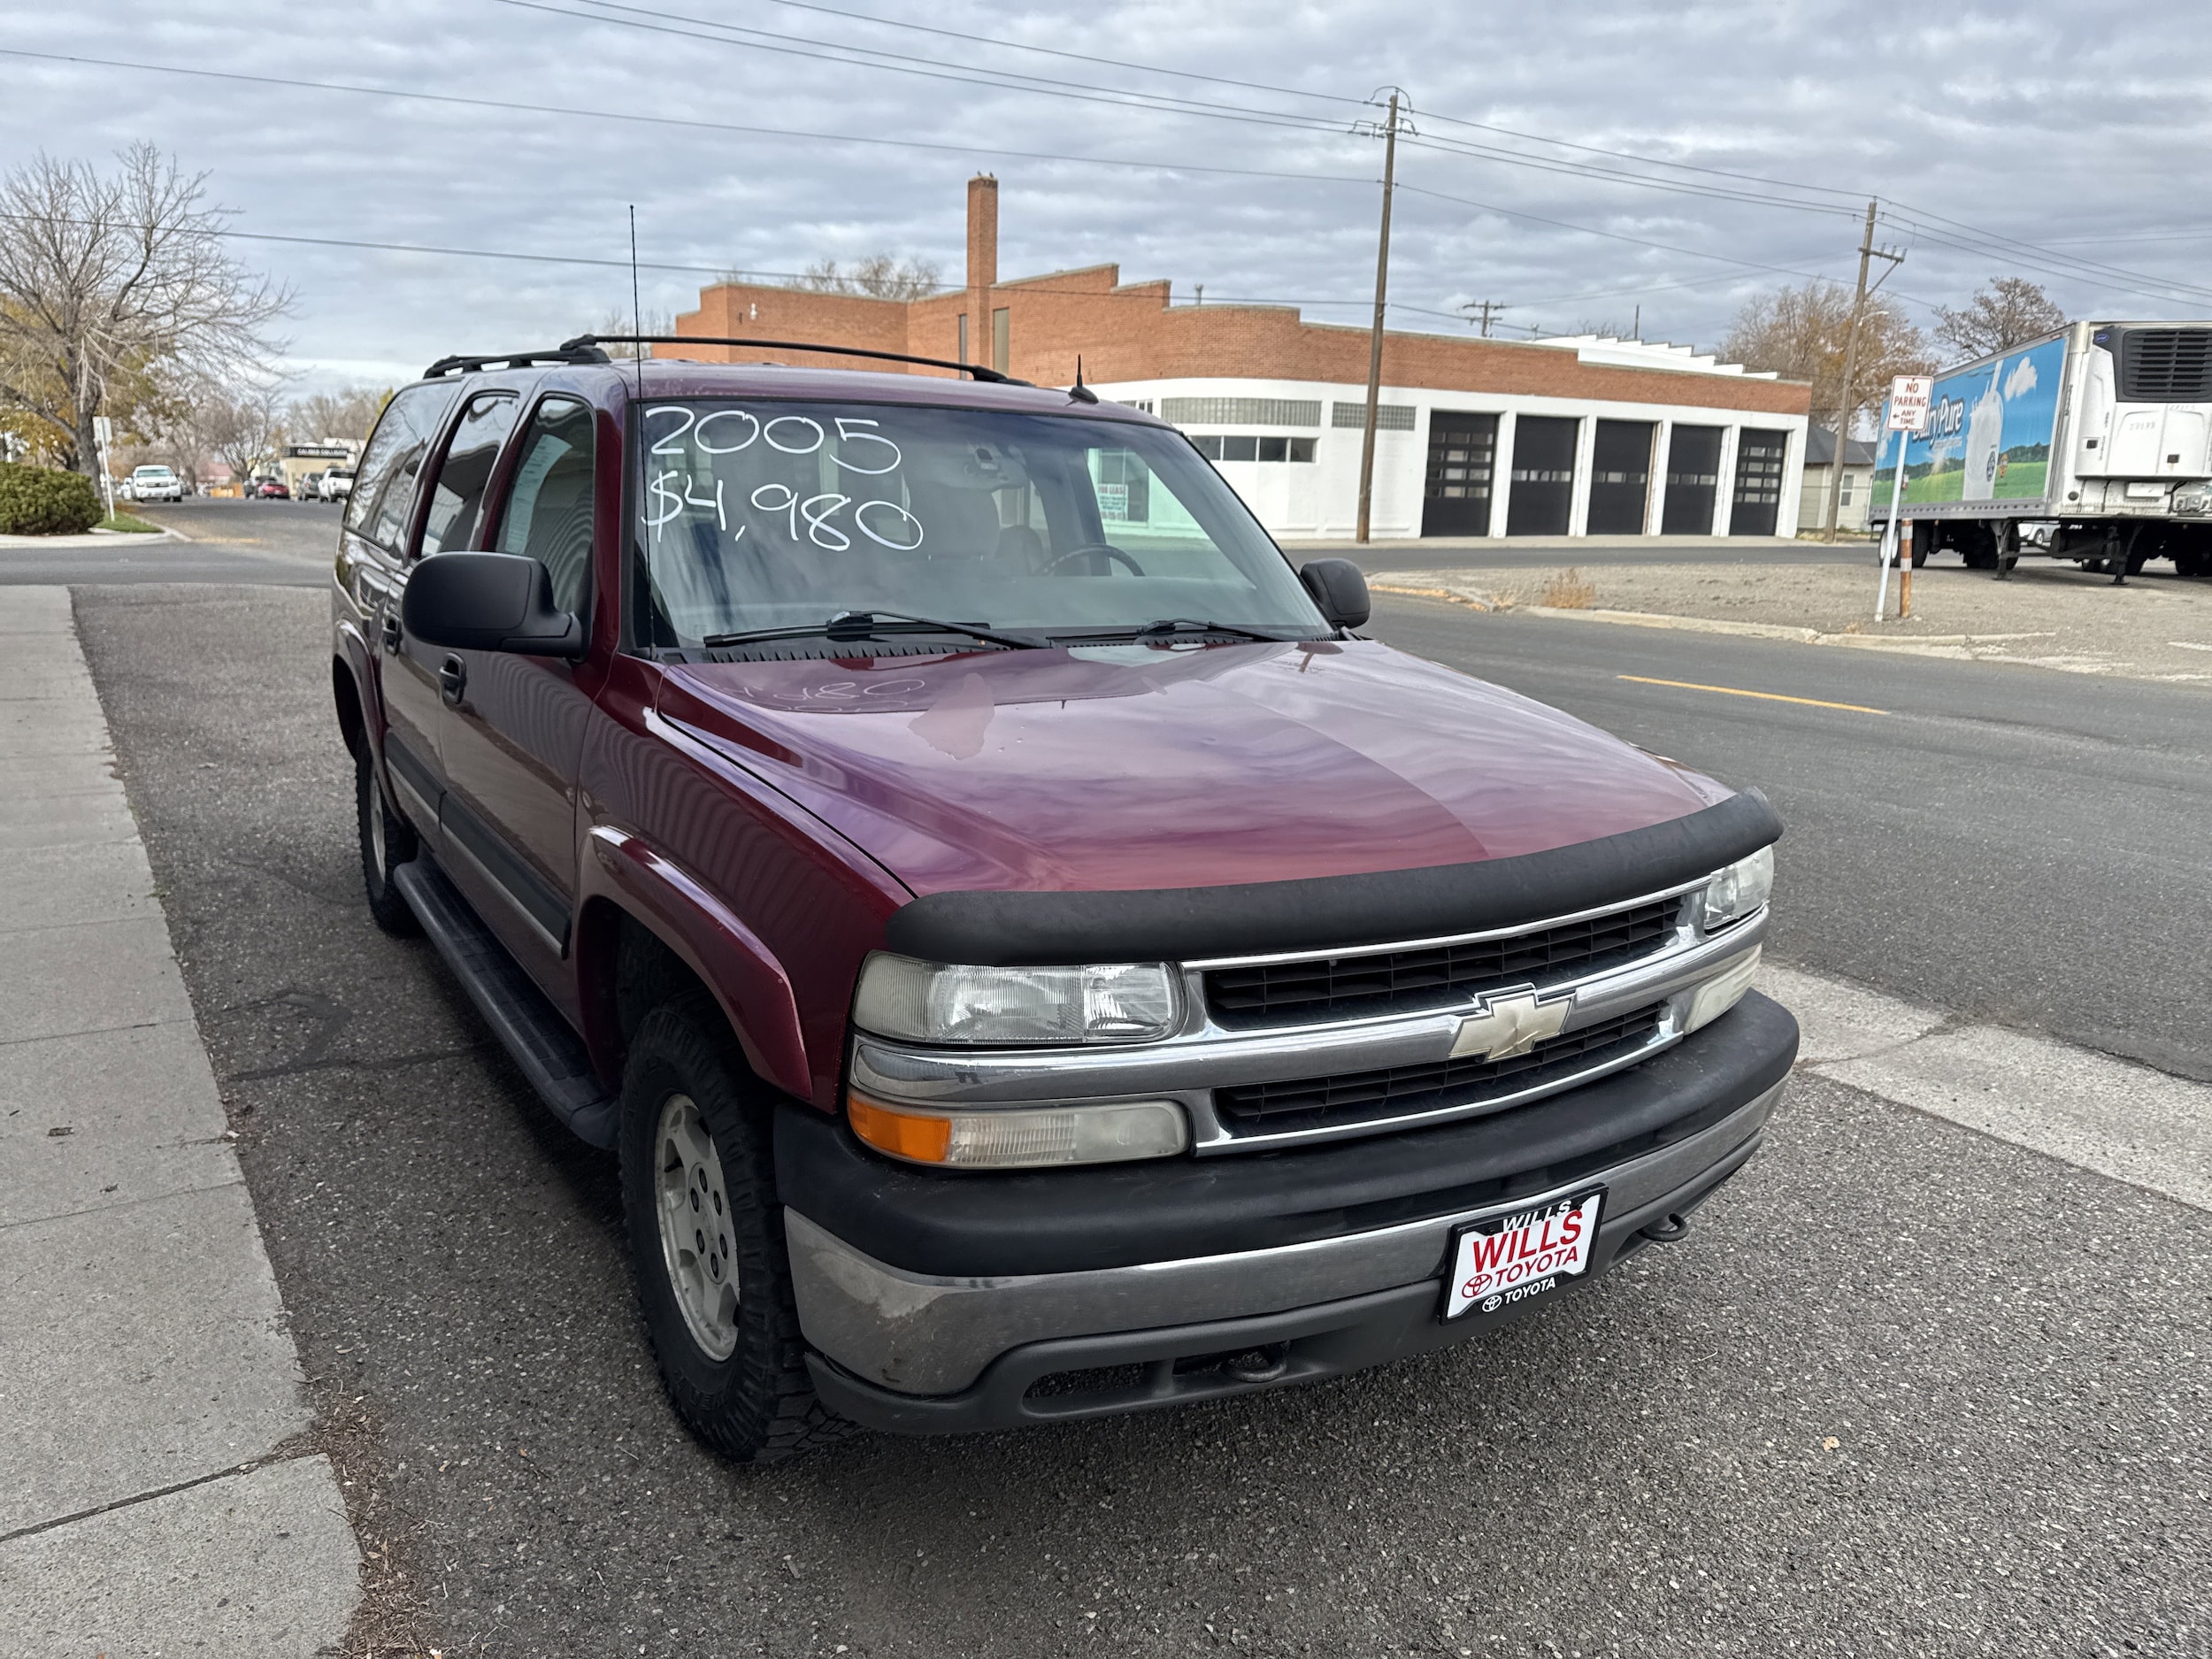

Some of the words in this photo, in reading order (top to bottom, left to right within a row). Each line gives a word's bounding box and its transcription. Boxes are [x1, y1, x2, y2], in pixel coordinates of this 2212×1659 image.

[1893, 396, 1927, 407] PARKING
[1906, 383, 1919, 393] NO
[645, 405, 902, 474] 2005
[641, 470, 924, 551] $4,980
[1502, 1200, 1572, 1232] WILLS
[1473, 1210, 1583, 1273] WILLS
[1495, 1246, 1578, 1287] TOYOTA
[1504, 1277, 1556, 1304] TOYOTA
